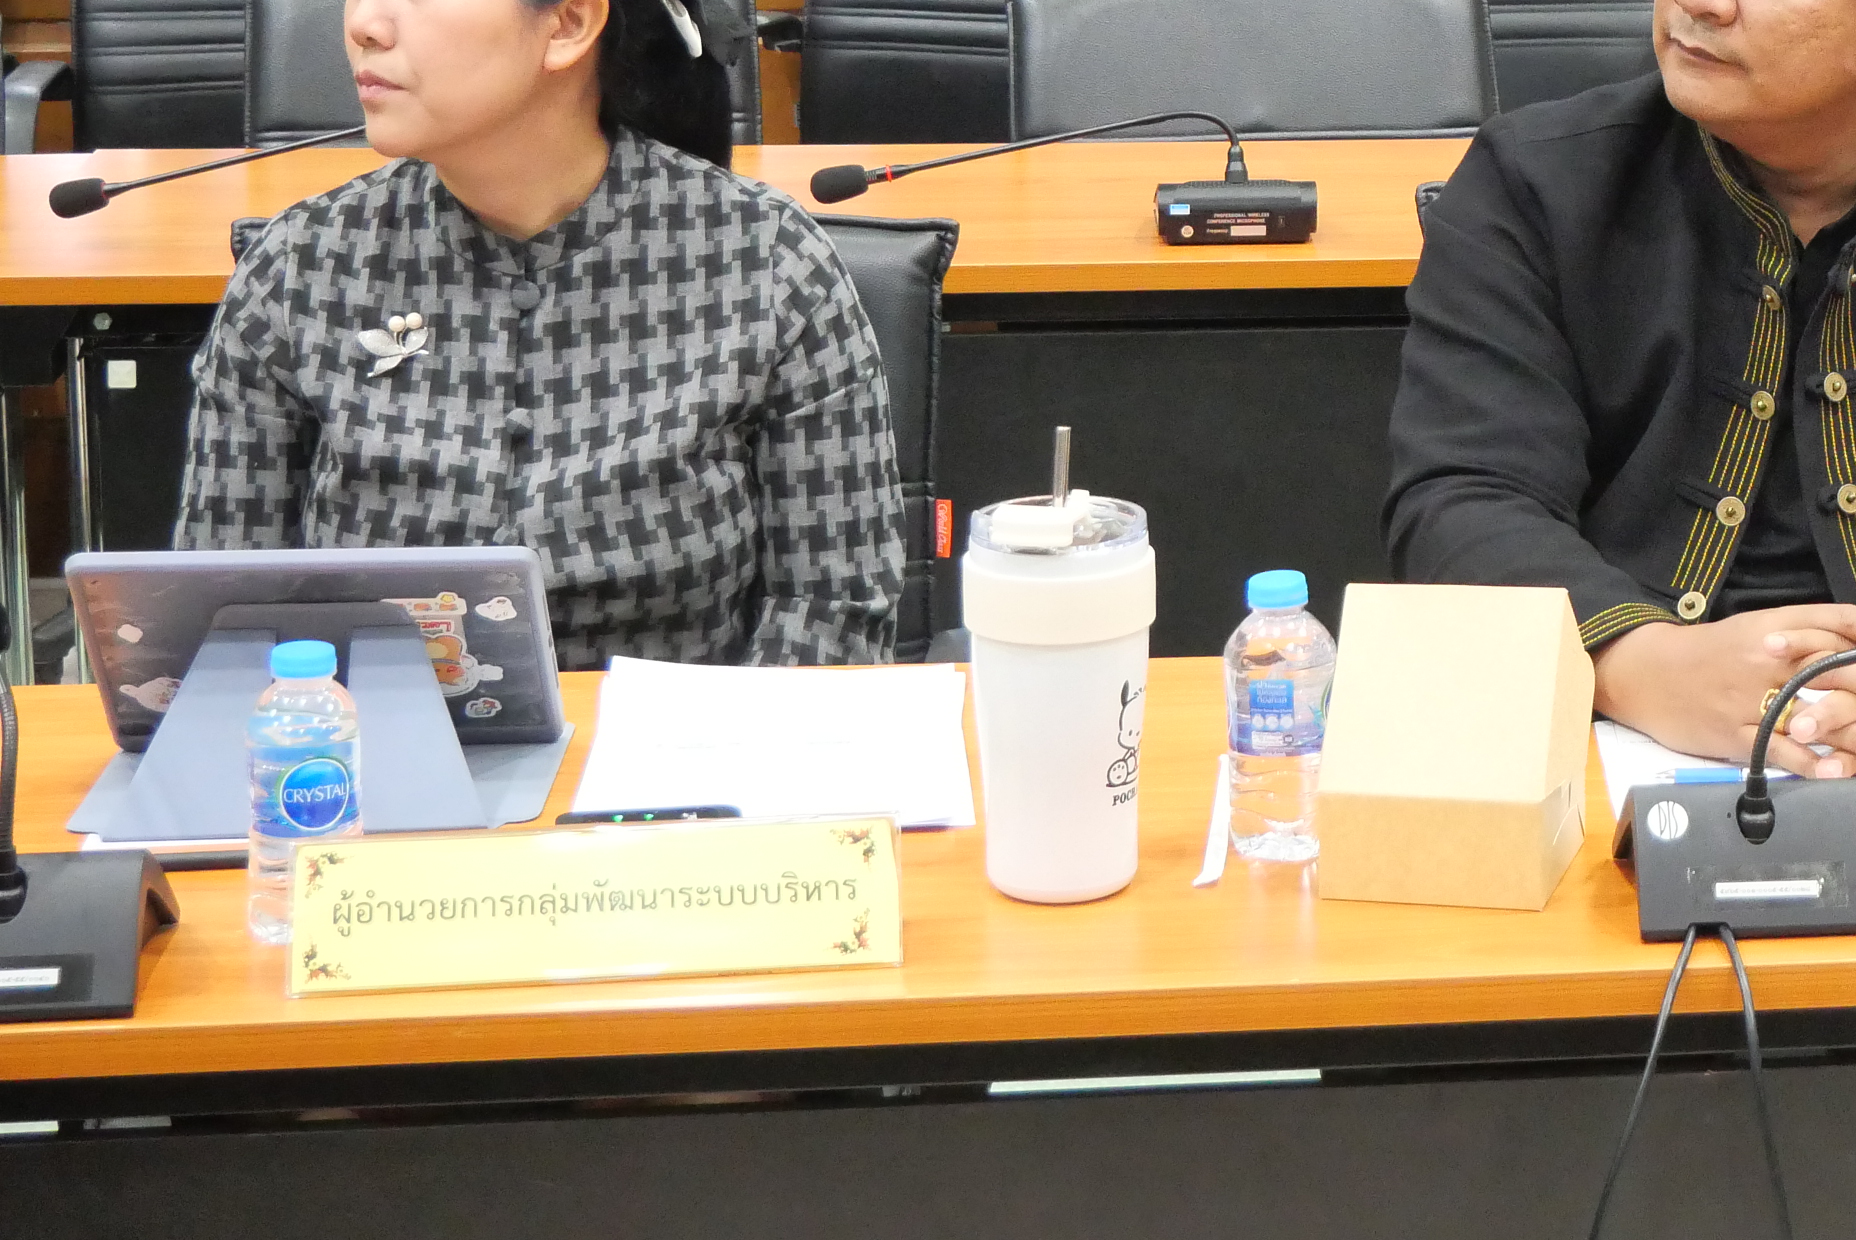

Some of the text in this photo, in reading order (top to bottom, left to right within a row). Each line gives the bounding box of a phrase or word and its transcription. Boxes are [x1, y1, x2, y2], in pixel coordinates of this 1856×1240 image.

[283, 782, 347, 804] CRYSTAL
[331, 870, 858, 938] ผู้อำนวยการกลุ่มพัฒนาระบบบริหาร
